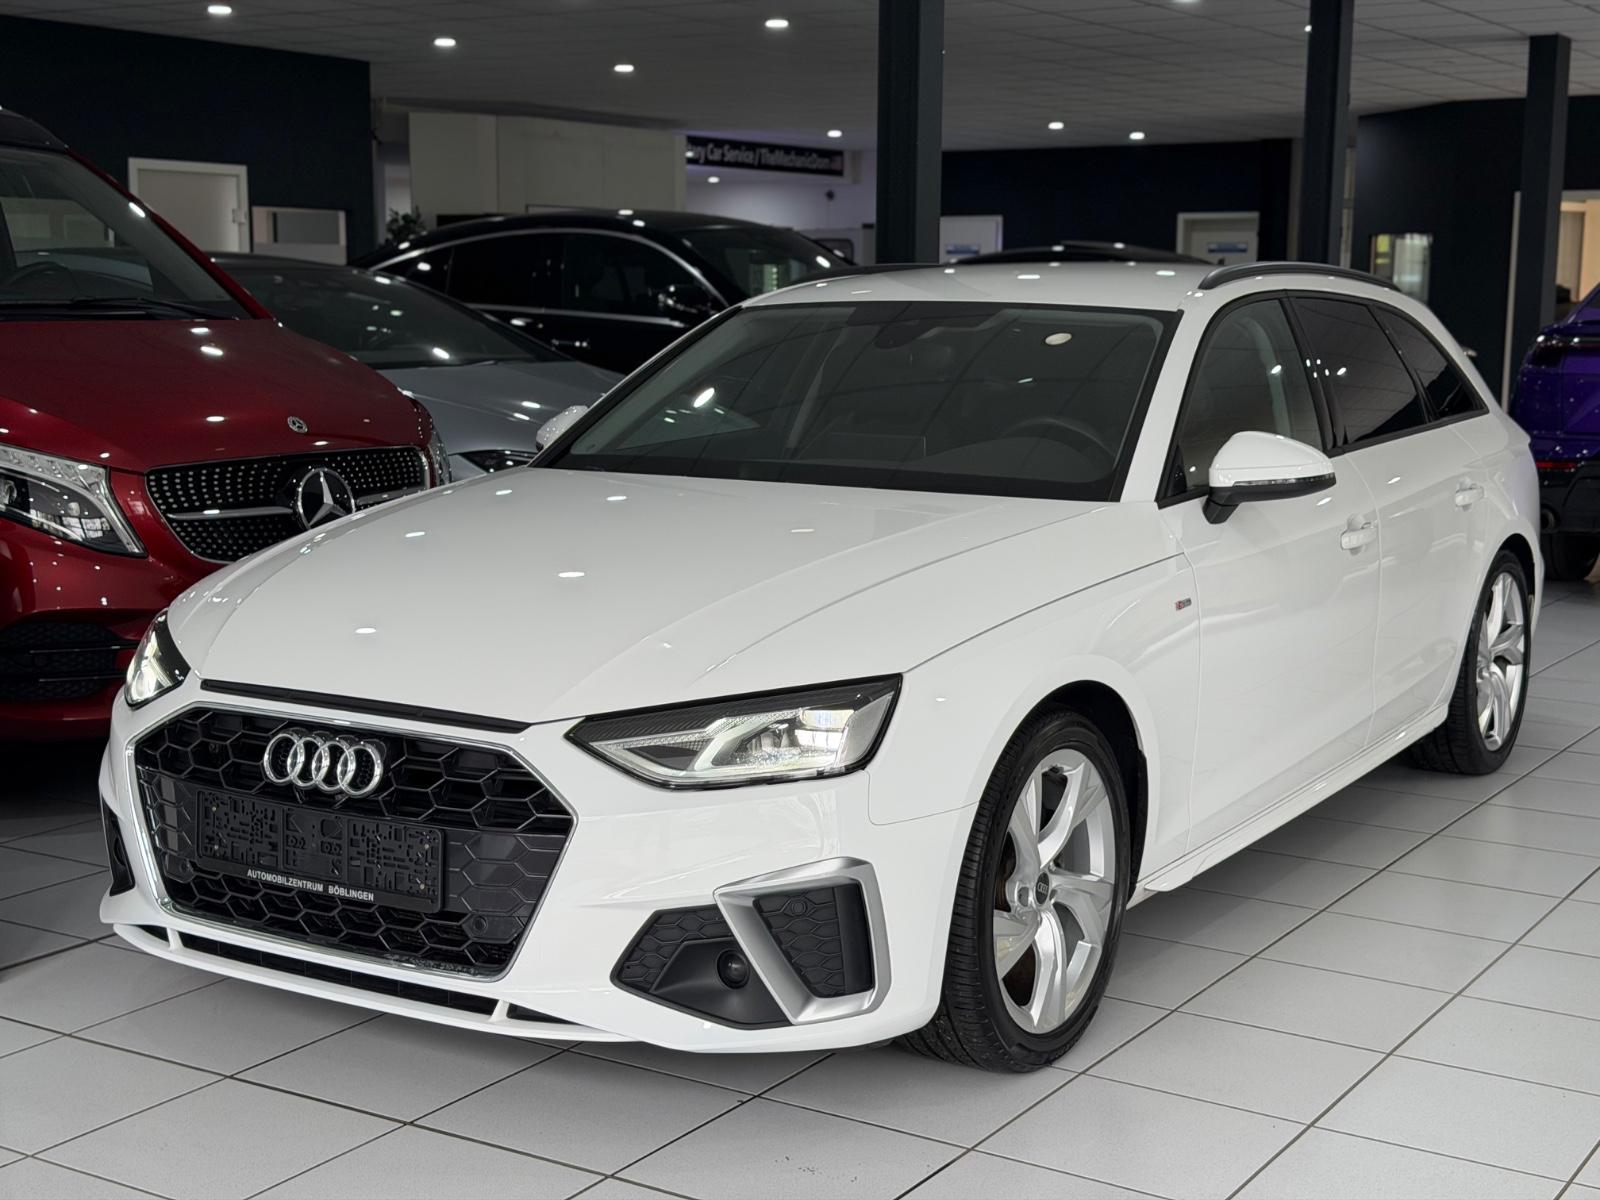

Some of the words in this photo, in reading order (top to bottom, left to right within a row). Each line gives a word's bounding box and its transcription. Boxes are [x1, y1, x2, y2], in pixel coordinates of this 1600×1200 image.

[707, 142, 722, 162] Car
[723, 143, 754, 164] Service
[247, 869, 324, 892] AUTOMOBILZENTRUM
[328, 885, 374, 902] BÖBLINGEN
